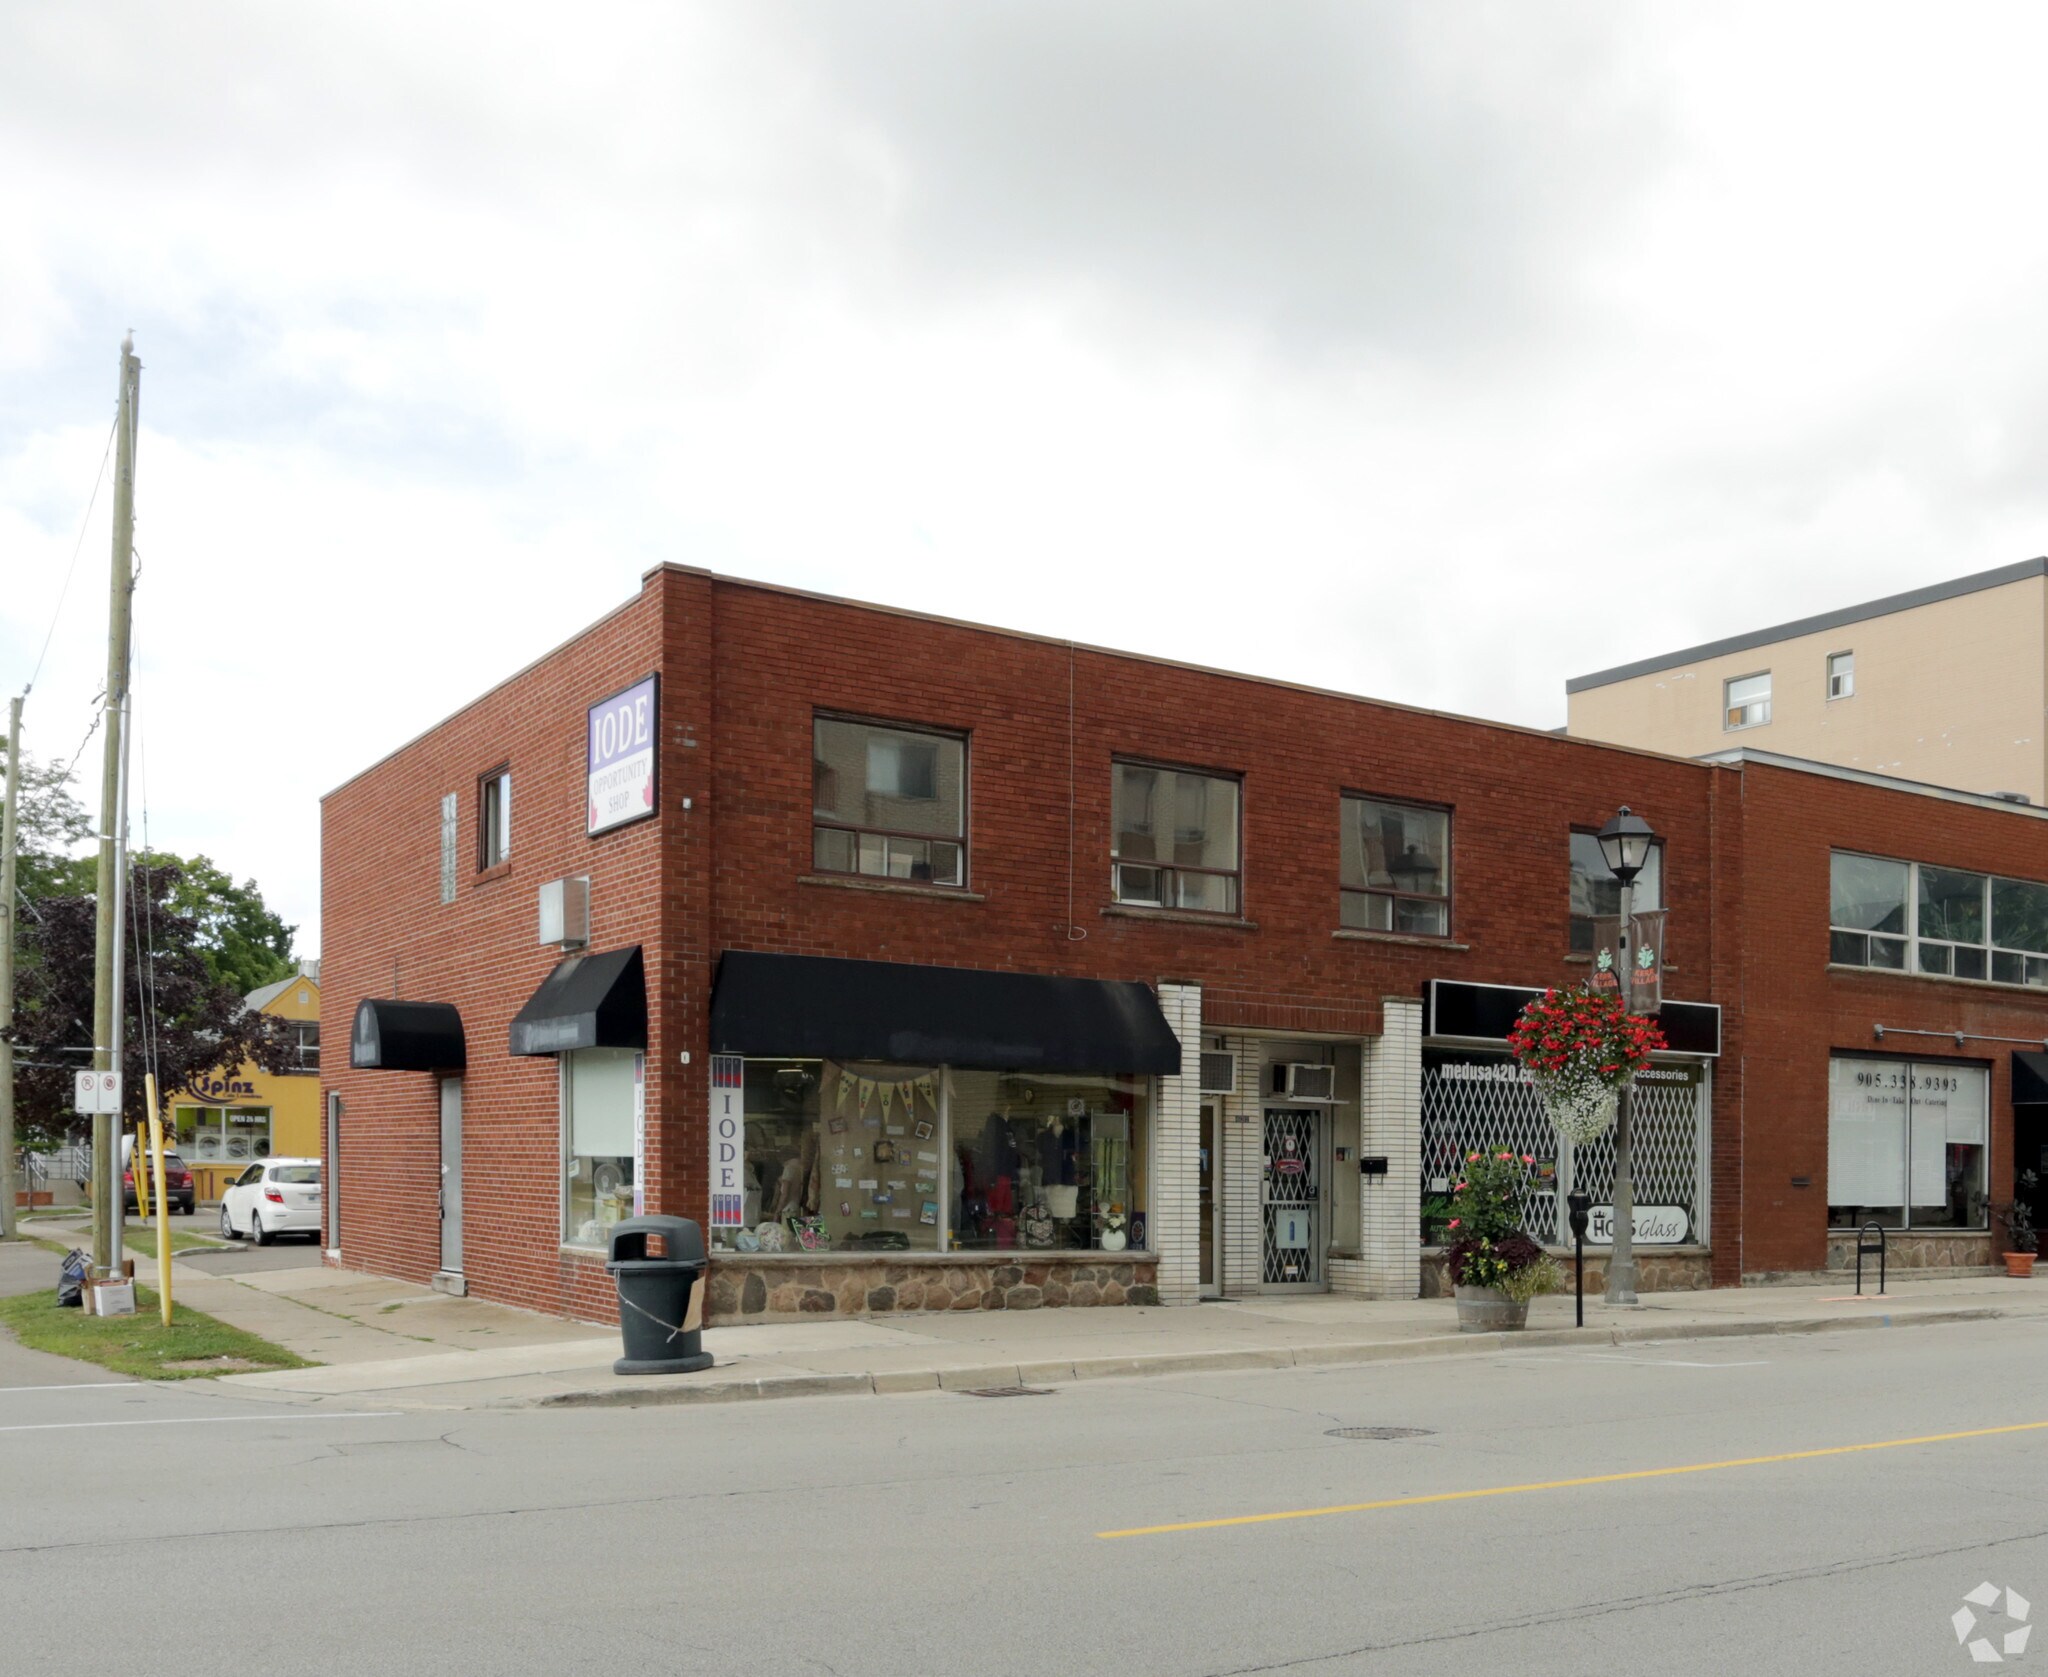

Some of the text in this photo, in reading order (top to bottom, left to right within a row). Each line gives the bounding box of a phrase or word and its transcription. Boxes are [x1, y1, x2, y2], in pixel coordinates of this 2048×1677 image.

[593, 694, 648, 764] IODE
[593, 757, 648, 795] OPPORTUNITY
[608, 791, 630, 814] SHOP
[1441, 1061, 1535, 1083] medusa420.co
[201, 1075, 255, 1096] Spinz
[718, 1094, 737, 1188] IODE
[1639, 1215, 1680, 1240] Glass
